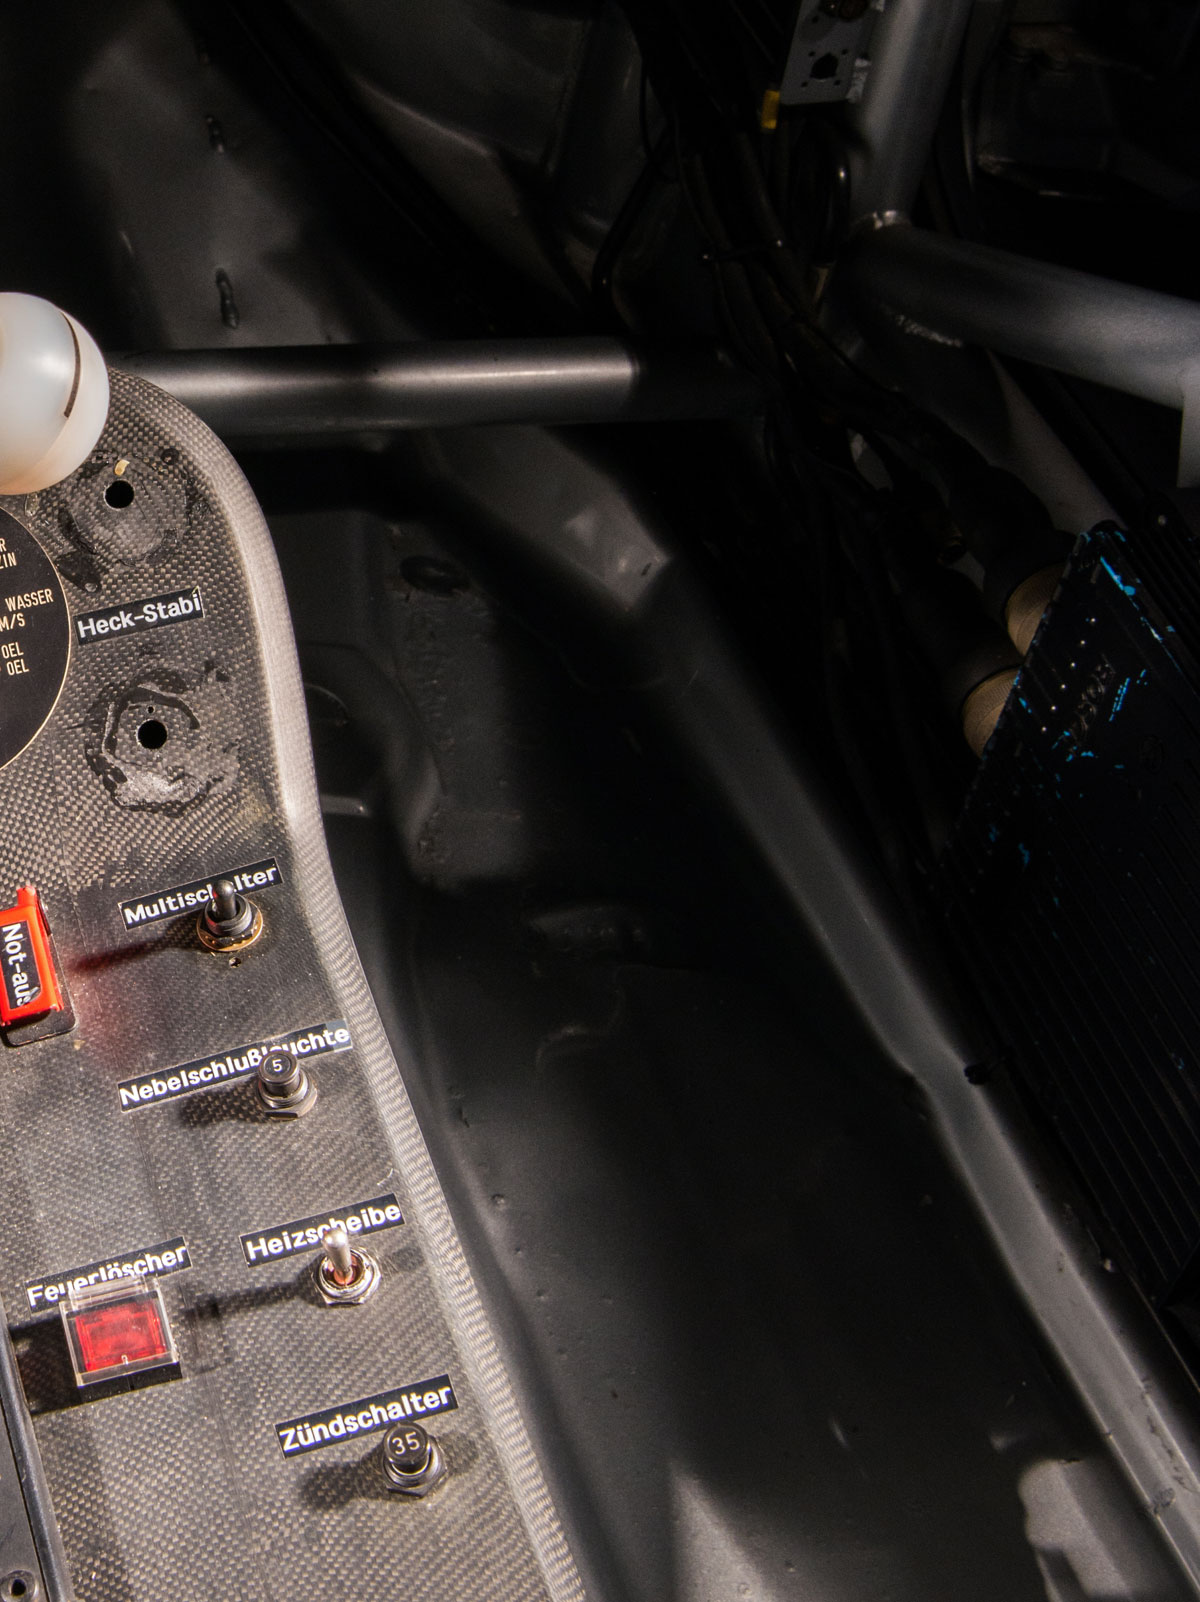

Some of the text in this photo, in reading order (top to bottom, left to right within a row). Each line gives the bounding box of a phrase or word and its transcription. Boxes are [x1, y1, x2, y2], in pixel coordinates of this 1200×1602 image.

[4, 588, 54, 612] WASSER
[77, 593, 201, 639] Heck-Stabi
[1, 641, 24, 659] OEL
[6, 658, 30, 676] OEL
[123, 866, 277, 925] Multisclter
[272, 1058, 283, 1073] 5
[279, 1385, 451, 1453] Zündschalter
[392, 1431, 421, 1455] 35
